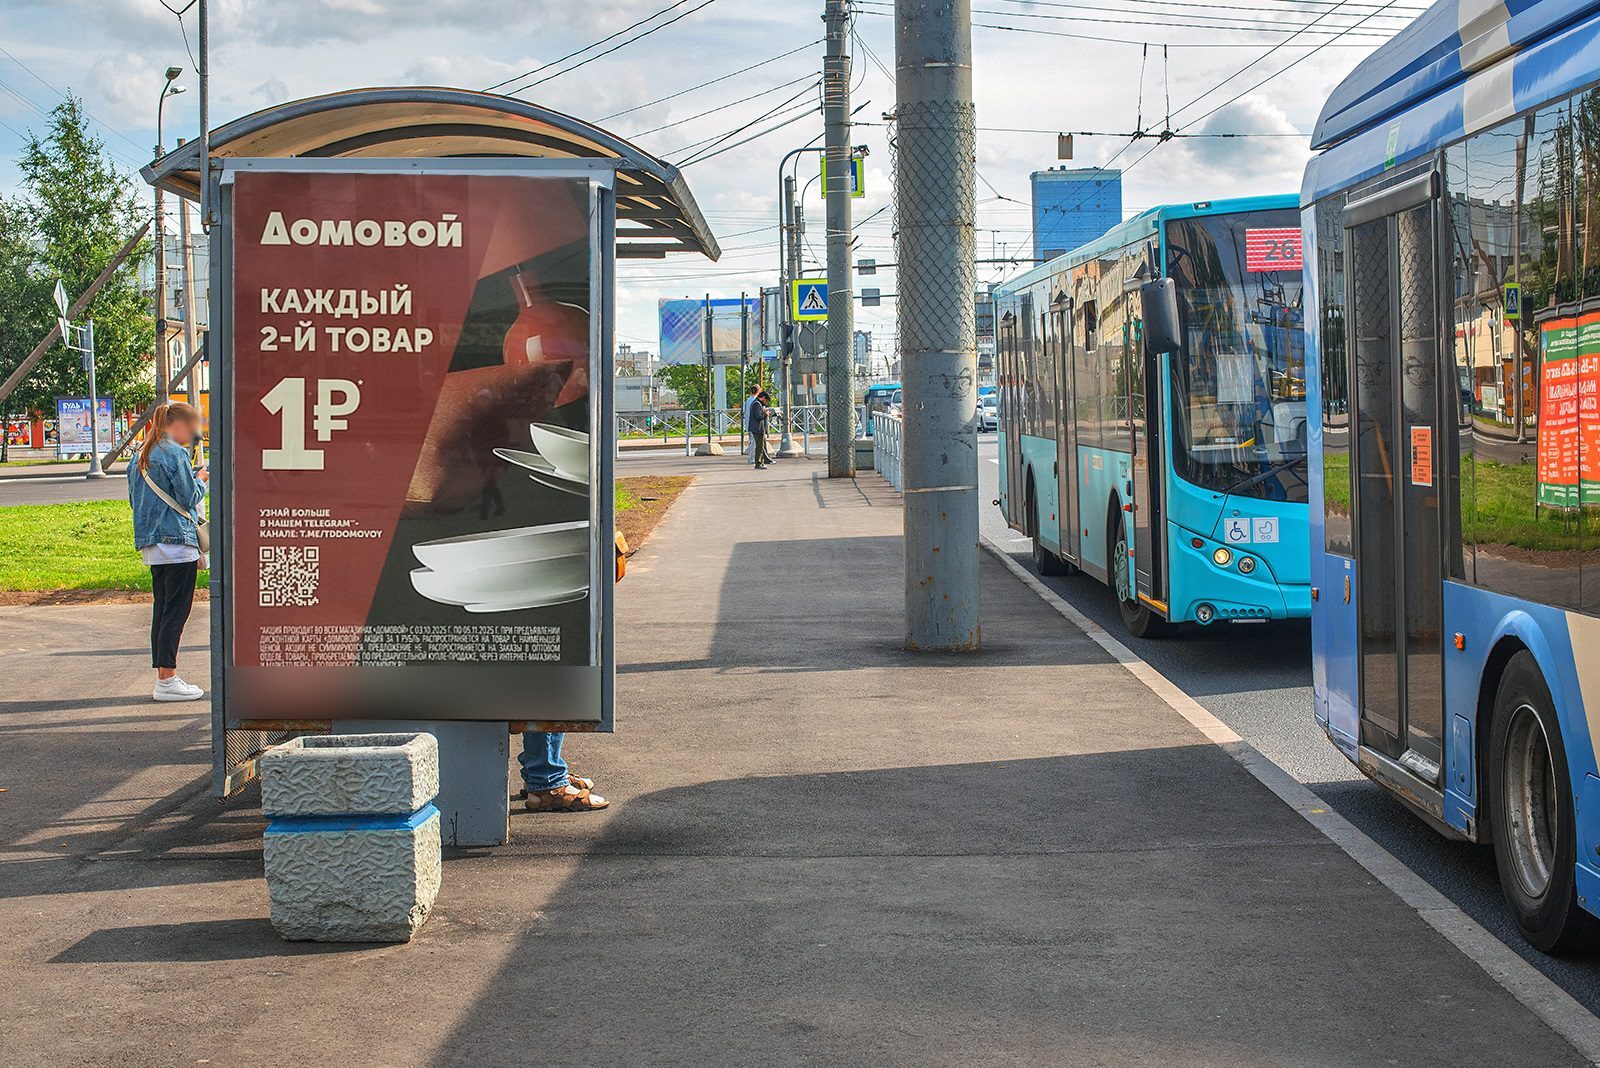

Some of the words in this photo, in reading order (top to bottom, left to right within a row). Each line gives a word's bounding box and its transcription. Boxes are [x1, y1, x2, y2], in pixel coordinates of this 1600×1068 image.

[1264, 240, 1294, 261] 26
[260, 282, 413, 318] КАЖДЫЙ
[259, 319, 316, 353] 2-Й
[325, 326, 434, 353] ТОВАР
[260, 507, 290, 517] УЗНАЙ
[291, 509, 331, 517] БОЛЬШЕ
[260, 519, 266, 528] В
[268, 519, 302, 528] НАШЕМ
[260, 530, 298, 538] КАНАЛЕ:
[300, 530, 383, 538] T.ME/TDDOMOVOY
